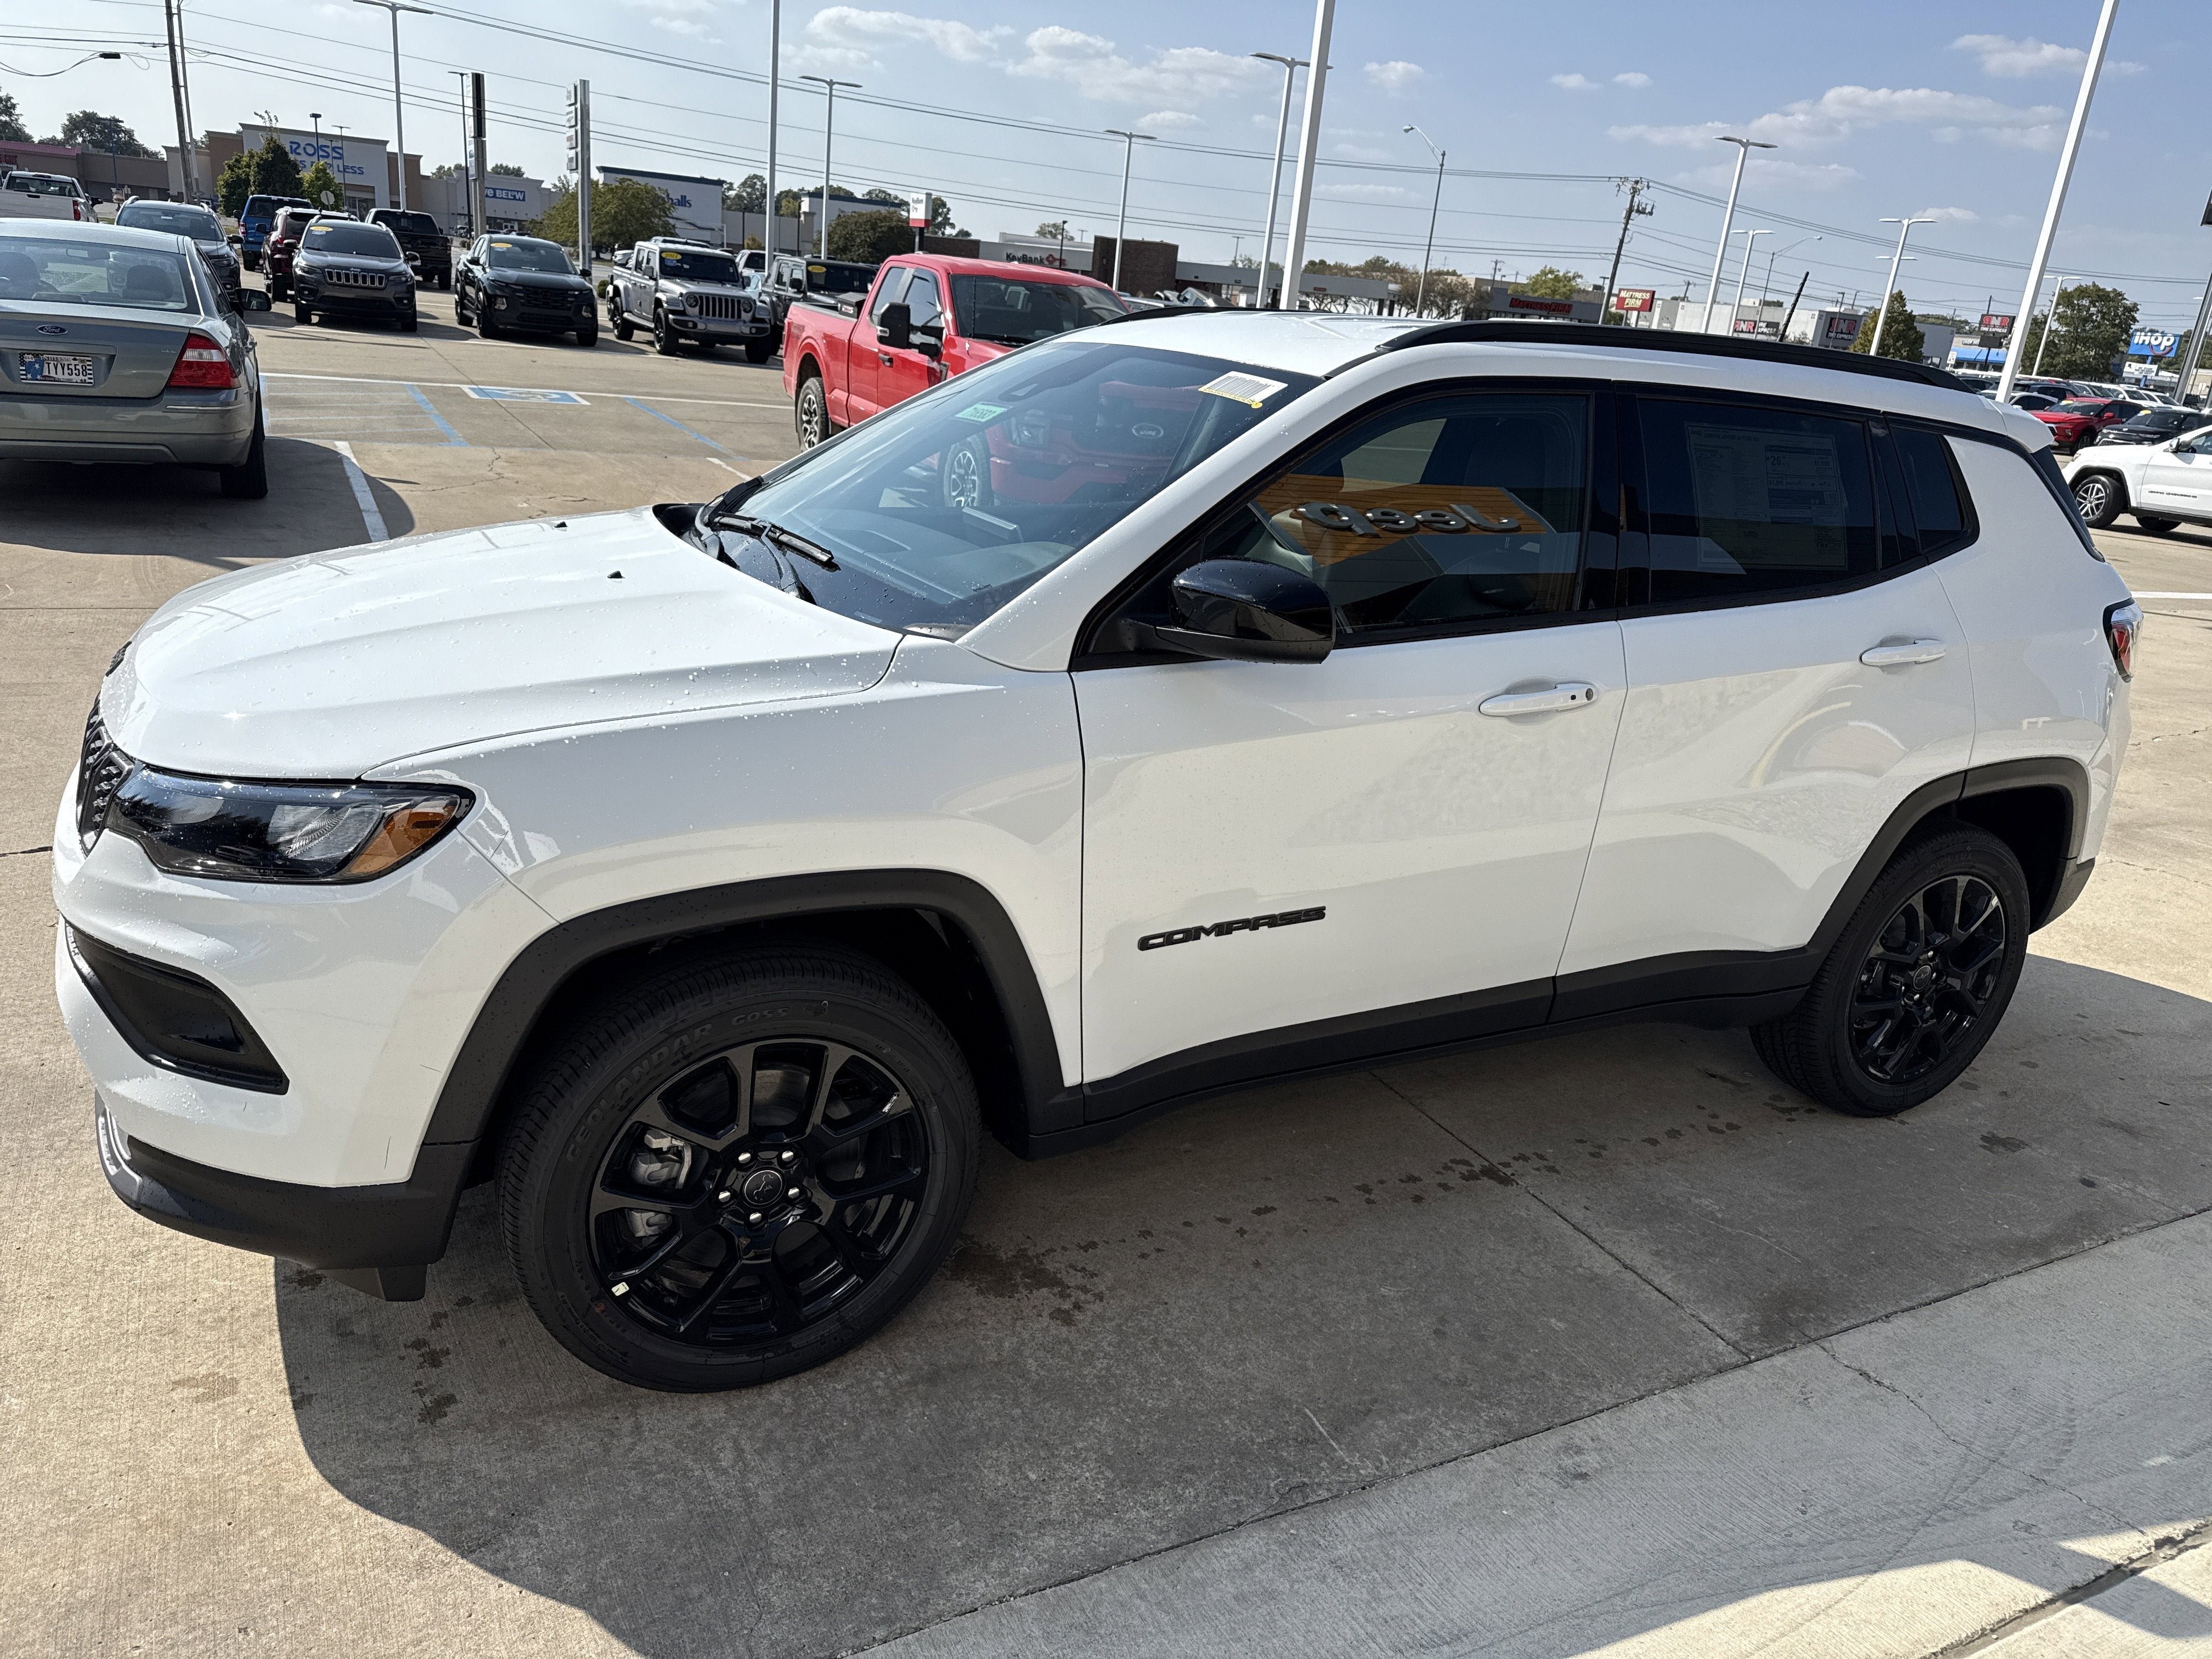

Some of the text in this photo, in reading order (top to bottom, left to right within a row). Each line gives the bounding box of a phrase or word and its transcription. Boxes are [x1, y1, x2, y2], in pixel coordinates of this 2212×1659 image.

[290, 141, 342, 160] ROSS
[337, 164, 364, 174] LESS
[496, 190, 524, 200] BELOW
[1006, 252, 1045, 264] KeyBank
[1619, 290, 1651, 300] MATTRESS
[1624, 298, 1643, 308] FIRM
[46, 362, 87, 377] TYY558
[1771, 455, 1781, 466] 26
[1137, 906, 1327, 951] COMPASS
[566, 1023, 713, 1162] GEOLANDAR
